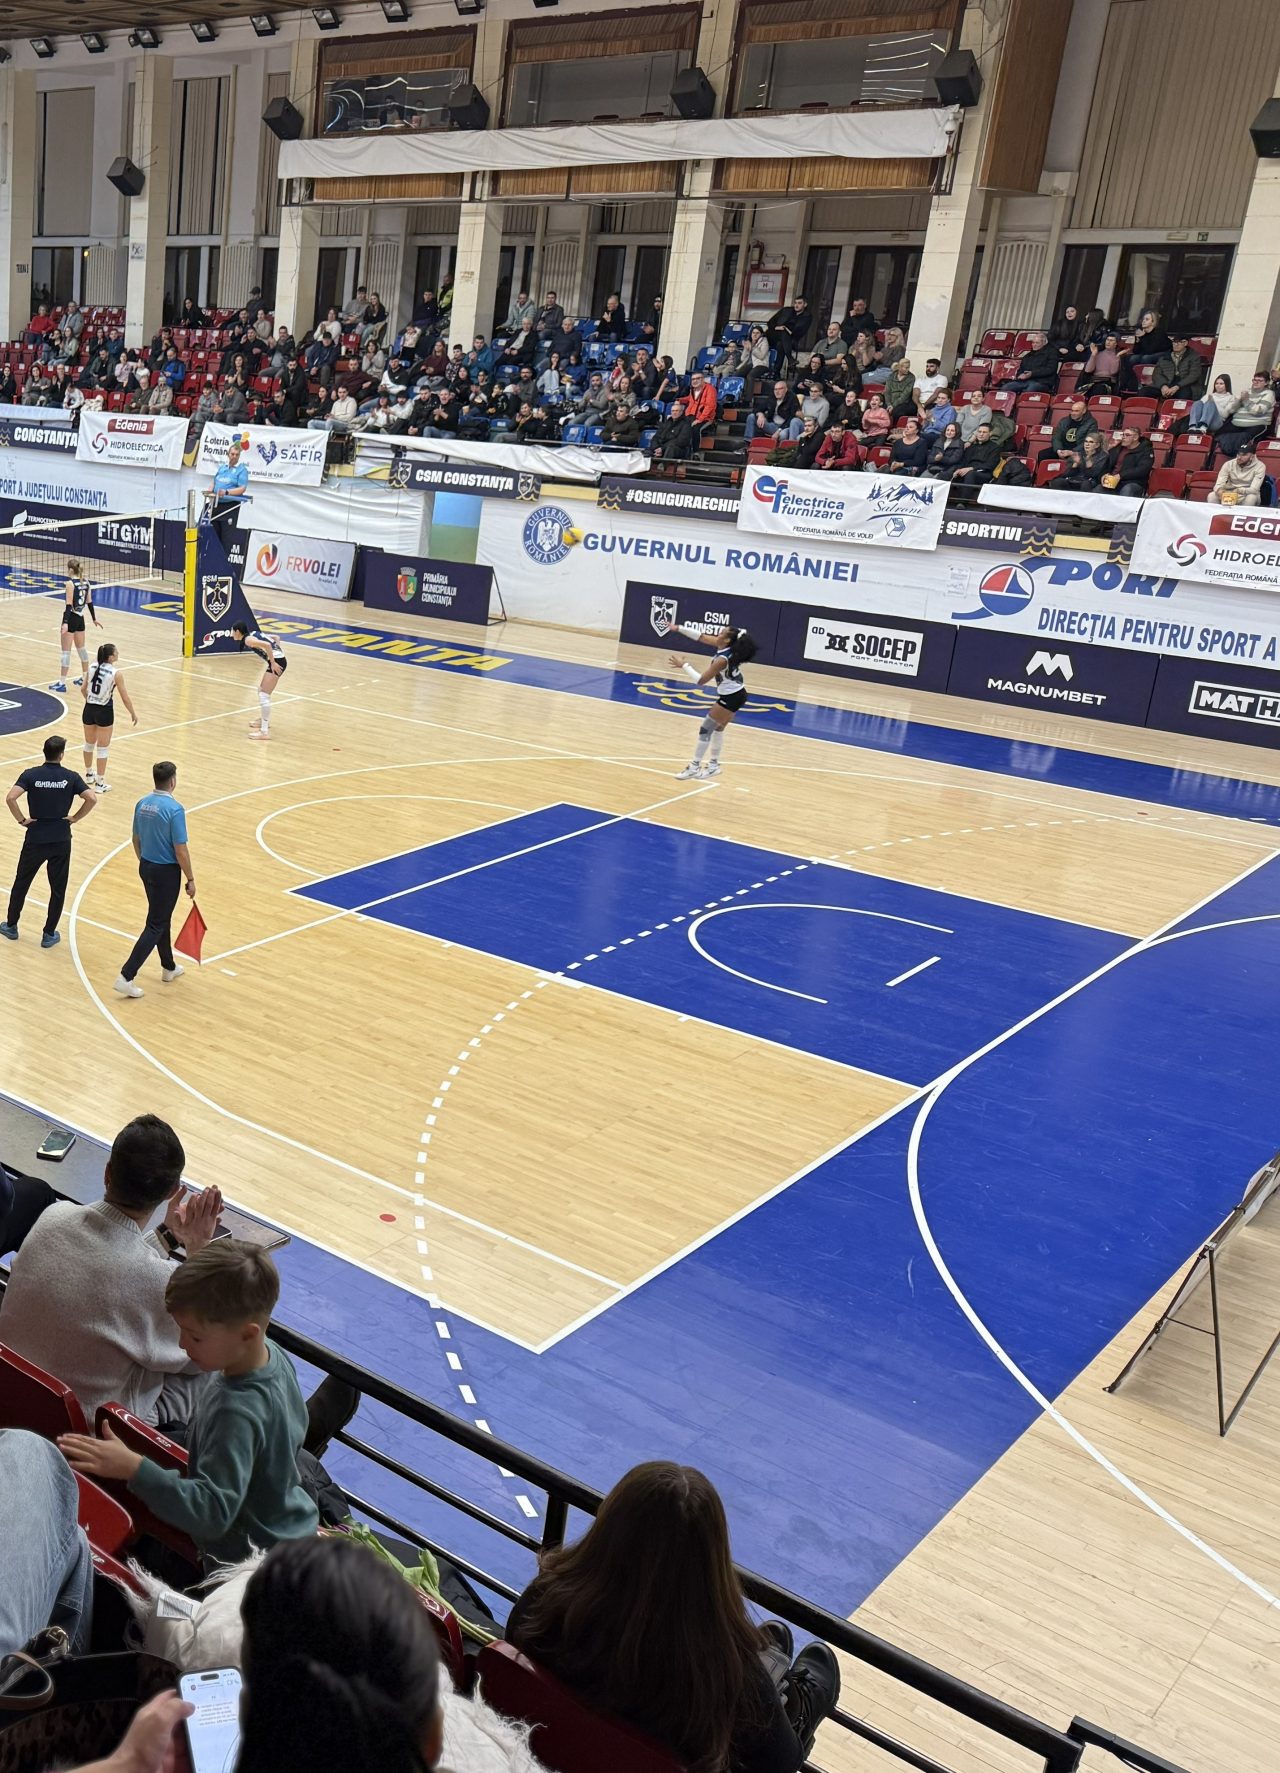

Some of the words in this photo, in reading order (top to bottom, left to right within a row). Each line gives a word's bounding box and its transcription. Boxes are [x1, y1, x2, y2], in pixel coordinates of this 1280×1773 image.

[115, 419, 148, 431] Edenia
[14, 427, 78, 448] CONSTANȚA
[110, 441, 164, 452] HIDROELECTRICA
[204, 436, 229, 446] Loteria
[204, 446, 229, 456] Român
[280, 449, 322, 462] SAFIR
[415, 469, 442, 484] CSM
[443, 471, 514, 491] CONSTANȚA
[18, 482, 23, 495] A
[24, 483, 63, 504] JUDEȚULUI
[64, 486, 108, 510] CONSTANȚA
[626, 489, 740, 513] #OSINGURAECHIP
[782, 506, 844, 521] furnizare
[857, 532, 874, 540] VOLEI
[946, 521, 1022, 541] SPORTIVI
[287, 556, 341, 578] FRVOLEI
[583, 532, 716, 565] GUVERNUL
[725, 552, 859, 583] ROMÂNIEI
[423, 573, 448, 584] PRIMĂRIA
[421, 594, 452, 607] CONSTANȚA
[704, 611, 730, 625] CSM
[1038, 608, 1116, 642] DIRECȚIA
[1120, 618, 1195, 650] PENTRU
[1197, 627, 1261, 658] SPORT
[1262, 637, 1277, 661] A
[852, 633, 917, 662] SOCEP
[987, 678, 1106, 705] MAGNUMBET
[1199, 690, 1254, 713] MAT
